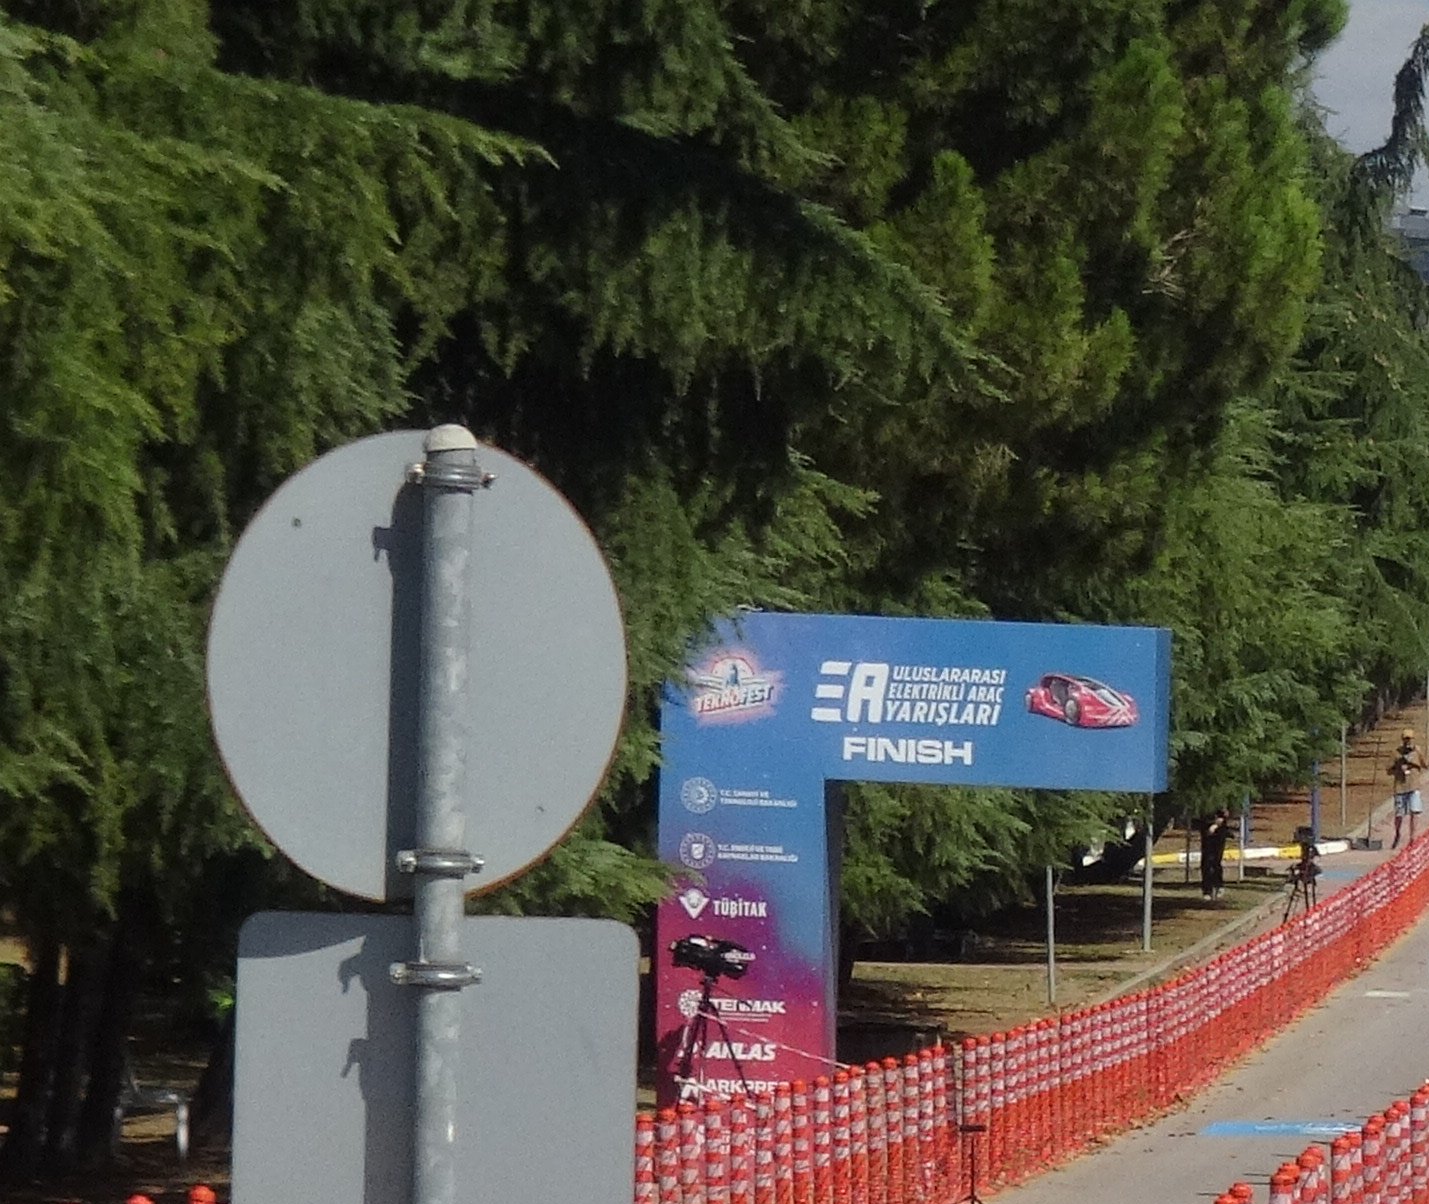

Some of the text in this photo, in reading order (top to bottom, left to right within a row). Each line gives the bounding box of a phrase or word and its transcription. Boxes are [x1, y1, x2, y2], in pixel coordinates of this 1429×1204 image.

[893, 666, 1006, 684] ULUSLARARASI
[888, 682, 965, 701] ELEKTRİKLİ
[886, 701, 1001, 726] YARIŞLARI
[843, 737, 974, 765] FINISH
[713, 897, 767, 918] TÜBİTAK
